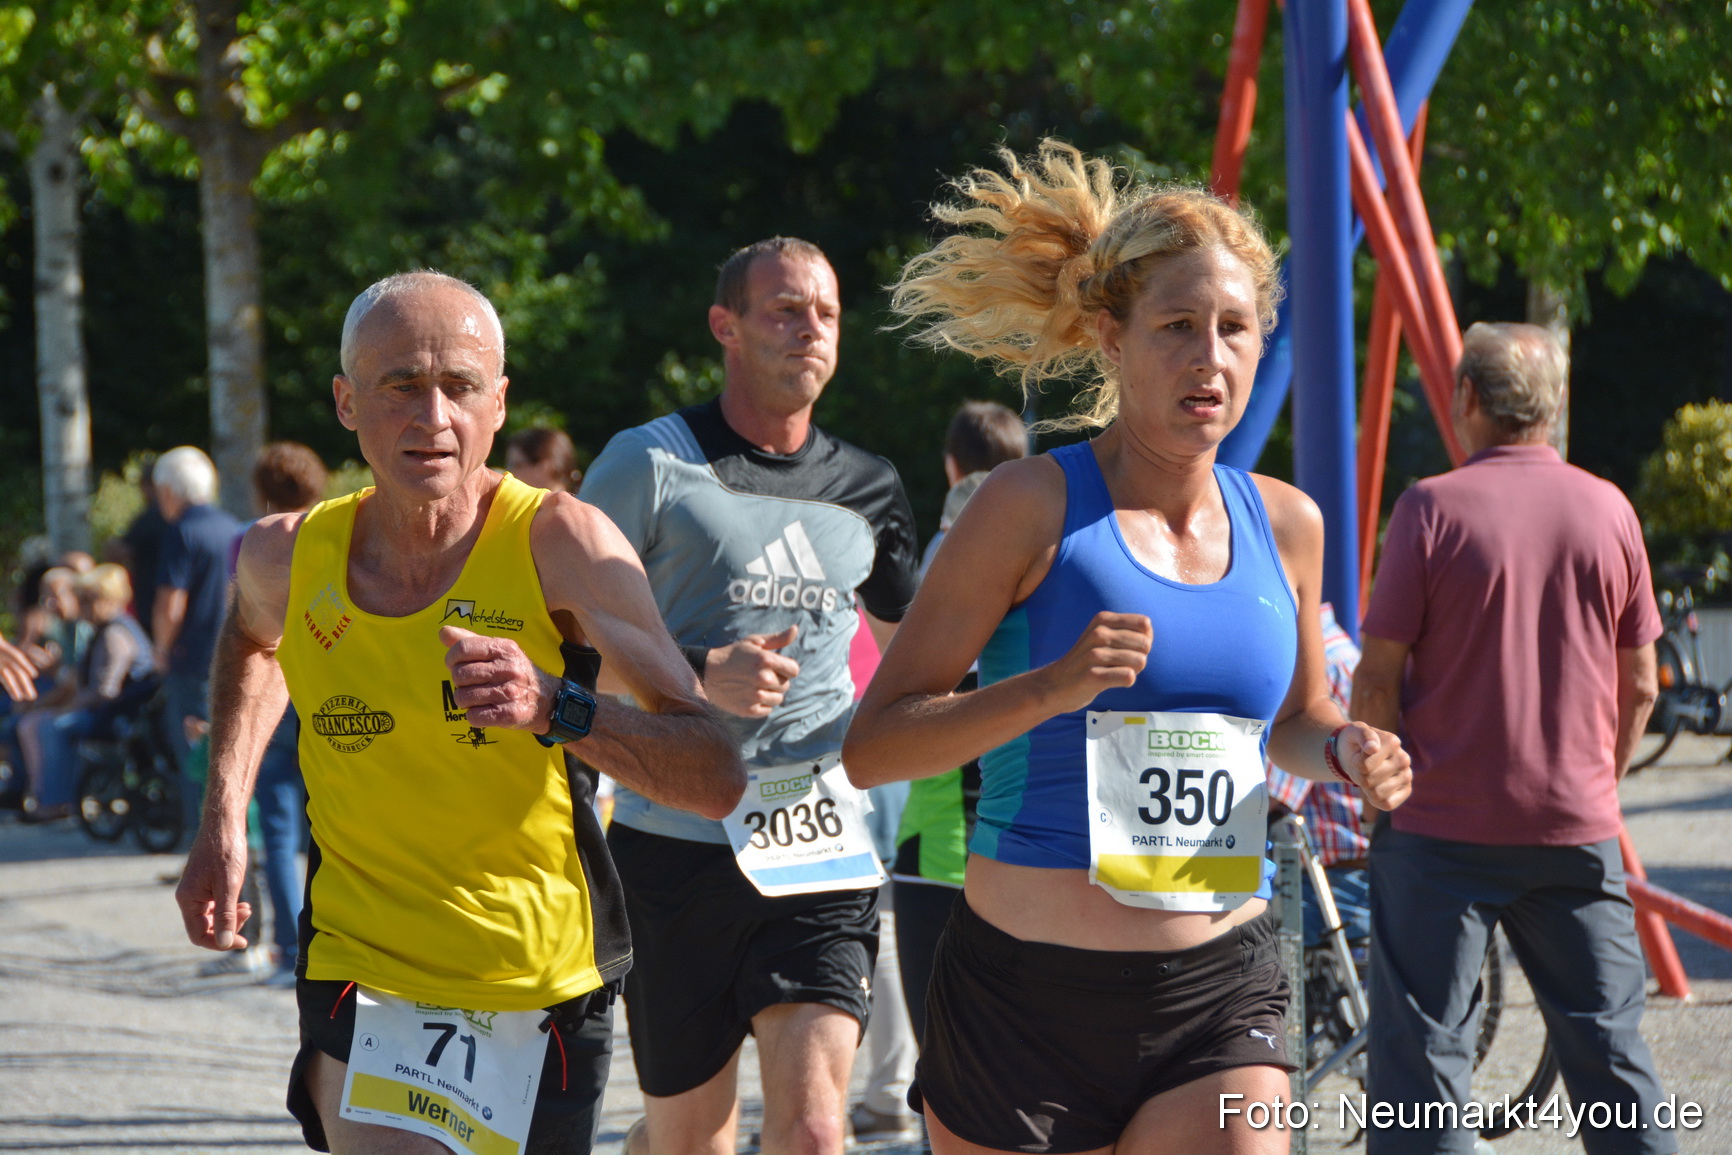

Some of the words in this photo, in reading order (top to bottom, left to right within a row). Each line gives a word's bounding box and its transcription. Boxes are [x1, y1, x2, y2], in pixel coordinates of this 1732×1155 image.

[729, 574, 837, 612] adidas
[304, 610, 332, 650] WERNER
[332, 614, 351, 639] BECK
[439, 605, 524, 631] Michelsberg
[320, 697, 367, 715] PIZZERIA
[317, 713, 381, 734] FRANCESCO
[327, 736, 372, 751] HERSBRUCK
[1148, 730, 1225, 750] BOCK
[760, 774, 813, 797] BOCK
[1138, 767, 1234, 827] 350
[744, 798, 843, 849] 3036
[1100, 812, 1107, 823] C
[1132, 835, 1173, 846] PARTL
[1176, 836, 1223, 847] Neumarkt
[365, 1037, 373, 1047] A
[423, 1022, 477, 1083] 71
[395, 1063, 434, 1085] PARTL
[437, 1078, 480, 1112] Neumarkt
[408, 1090, 475, 1143] Werner
